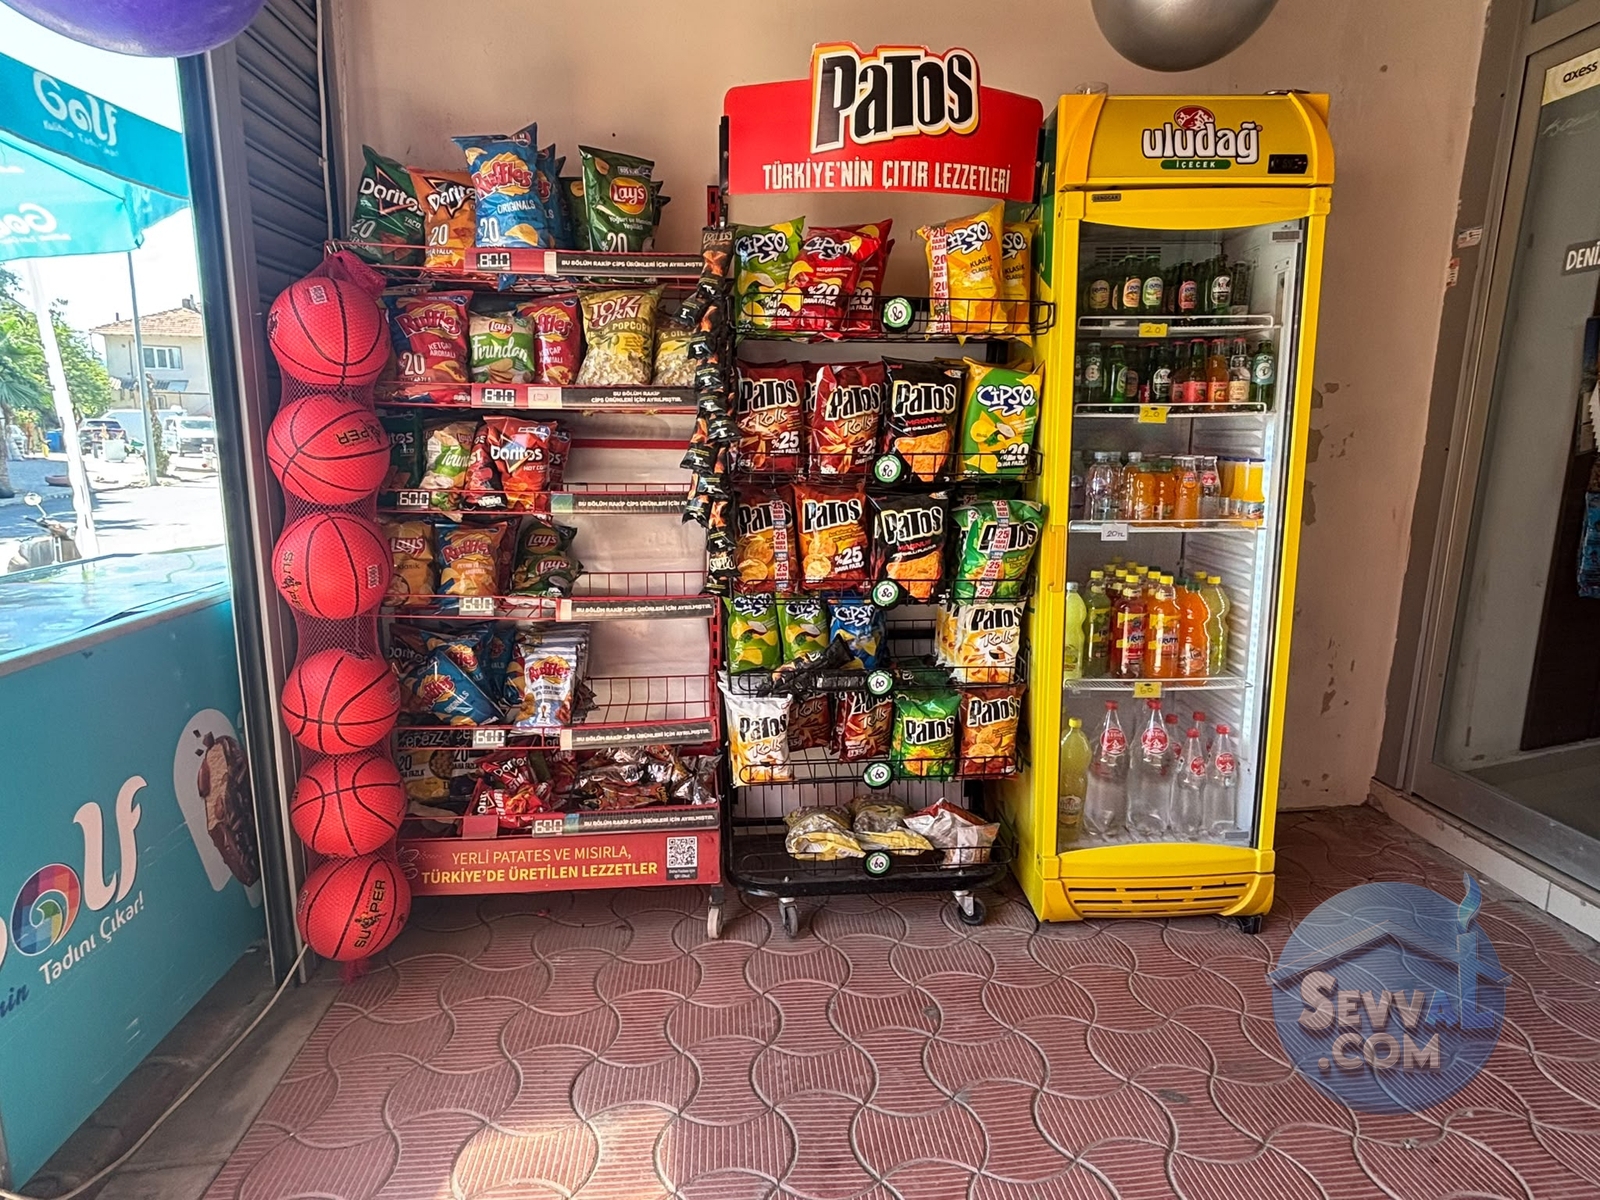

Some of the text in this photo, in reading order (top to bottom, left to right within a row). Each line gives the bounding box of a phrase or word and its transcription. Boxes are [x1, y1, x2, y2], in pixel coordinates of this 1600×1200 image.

[1563, 61, 1599, 83] axess
[33, 71, 118, 146] Golf
[1142, 121, 1260, 163] uludağ
[1175, 159, 1216, 169] İÇECEK
[472, 161, 533, 200] Ruffles
[763, 157, 1011, 194] TÜRKİYE'NİN ÇITIR LEZZETLERİ
[360, 177, 425, 217] Doritos
[427, 186, 476, 212] Dorito
[613, 184, 645, 206] Lay's
[497, 200, 536, 214] ORIGINALS
[404, 216, 422, 229] TACO
[946, 221, 991, 246] IPSO
[970, 254, 992, 268] KLASİK
[808, 283, 839, 300] %20
[398, 309, 462, 337] Ruffles
[537, 313, 573, 336] ffles
[755, 409, 788, 427] Rolls
[771, 431, 799, 449] %25
[491, 444, 543, 461] Doritos
[835, 546, 862, 565] %25
[980, 632, 1015, 648] Rolls
[748, 739, 783, 758] Rolls
[452, 845, 631, 865] YERLİ PATATES VE MISIRLA,
[0, 775, 148, 969] olf
[422, 867, 505, 884] TÜRKİYE'DE
[509, 864, 579, 881] ÜRETİLEN
[582, 862, 657, 878] LEZZETLER
[39, 890, 145, 985] Tadını Çıkar!
